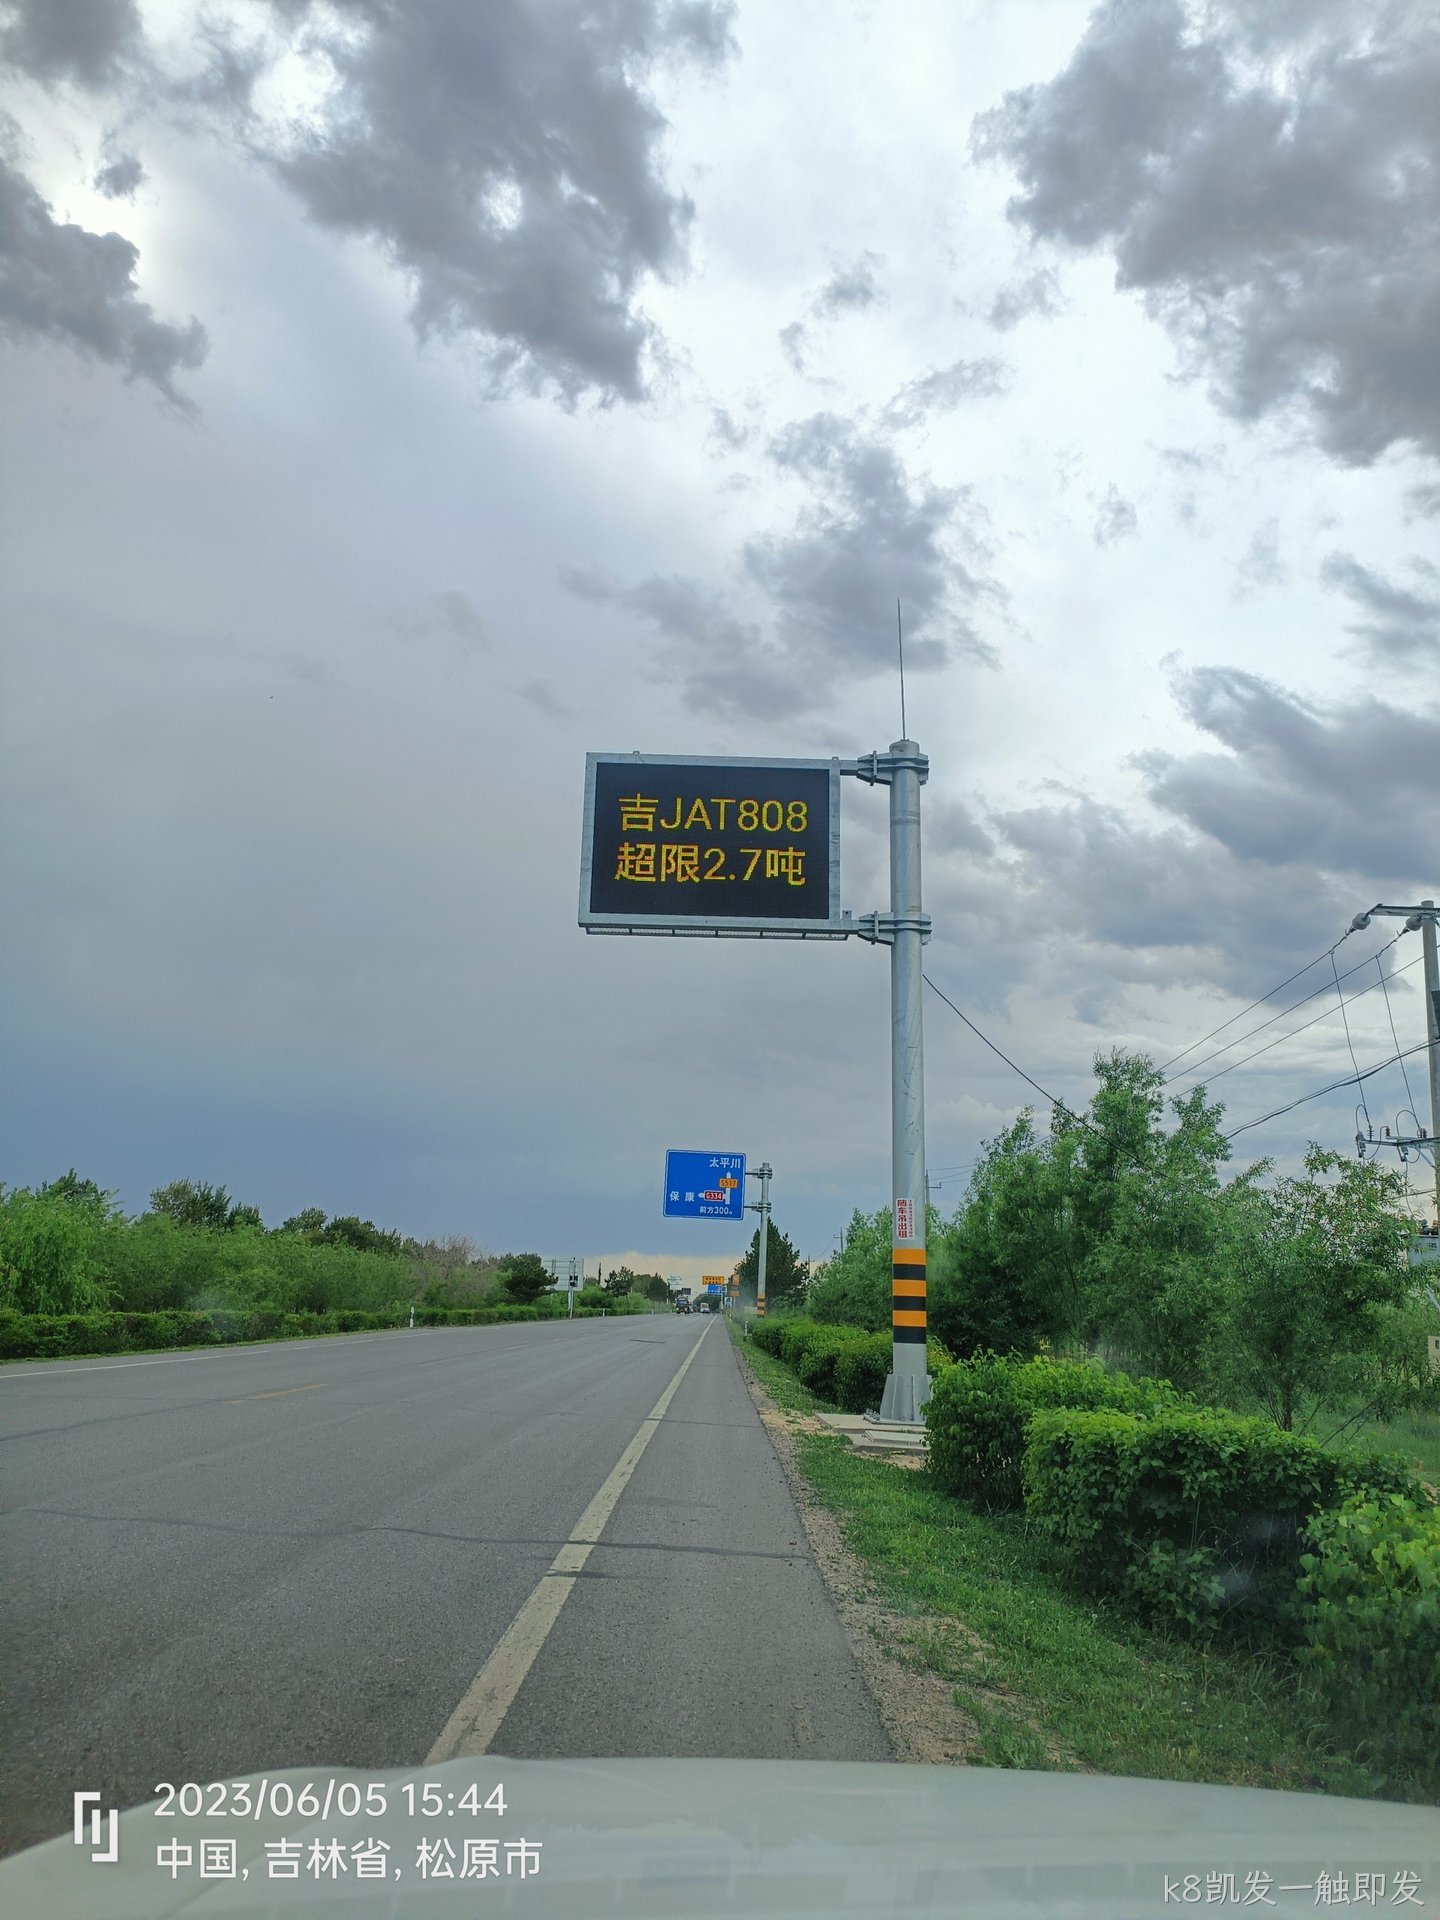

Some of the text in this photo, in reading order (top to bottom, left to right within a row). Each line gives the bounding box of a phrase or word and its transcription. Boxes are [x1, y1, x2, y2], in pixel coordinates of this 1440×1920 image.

[618, 793, 809, 832] 吉JAT808
[614, 842, 807, 886] 超限2.7吨
[709, 1157, 741, 1169] 太平川
[897, 1199, 908, 1238] 随车吊出租
